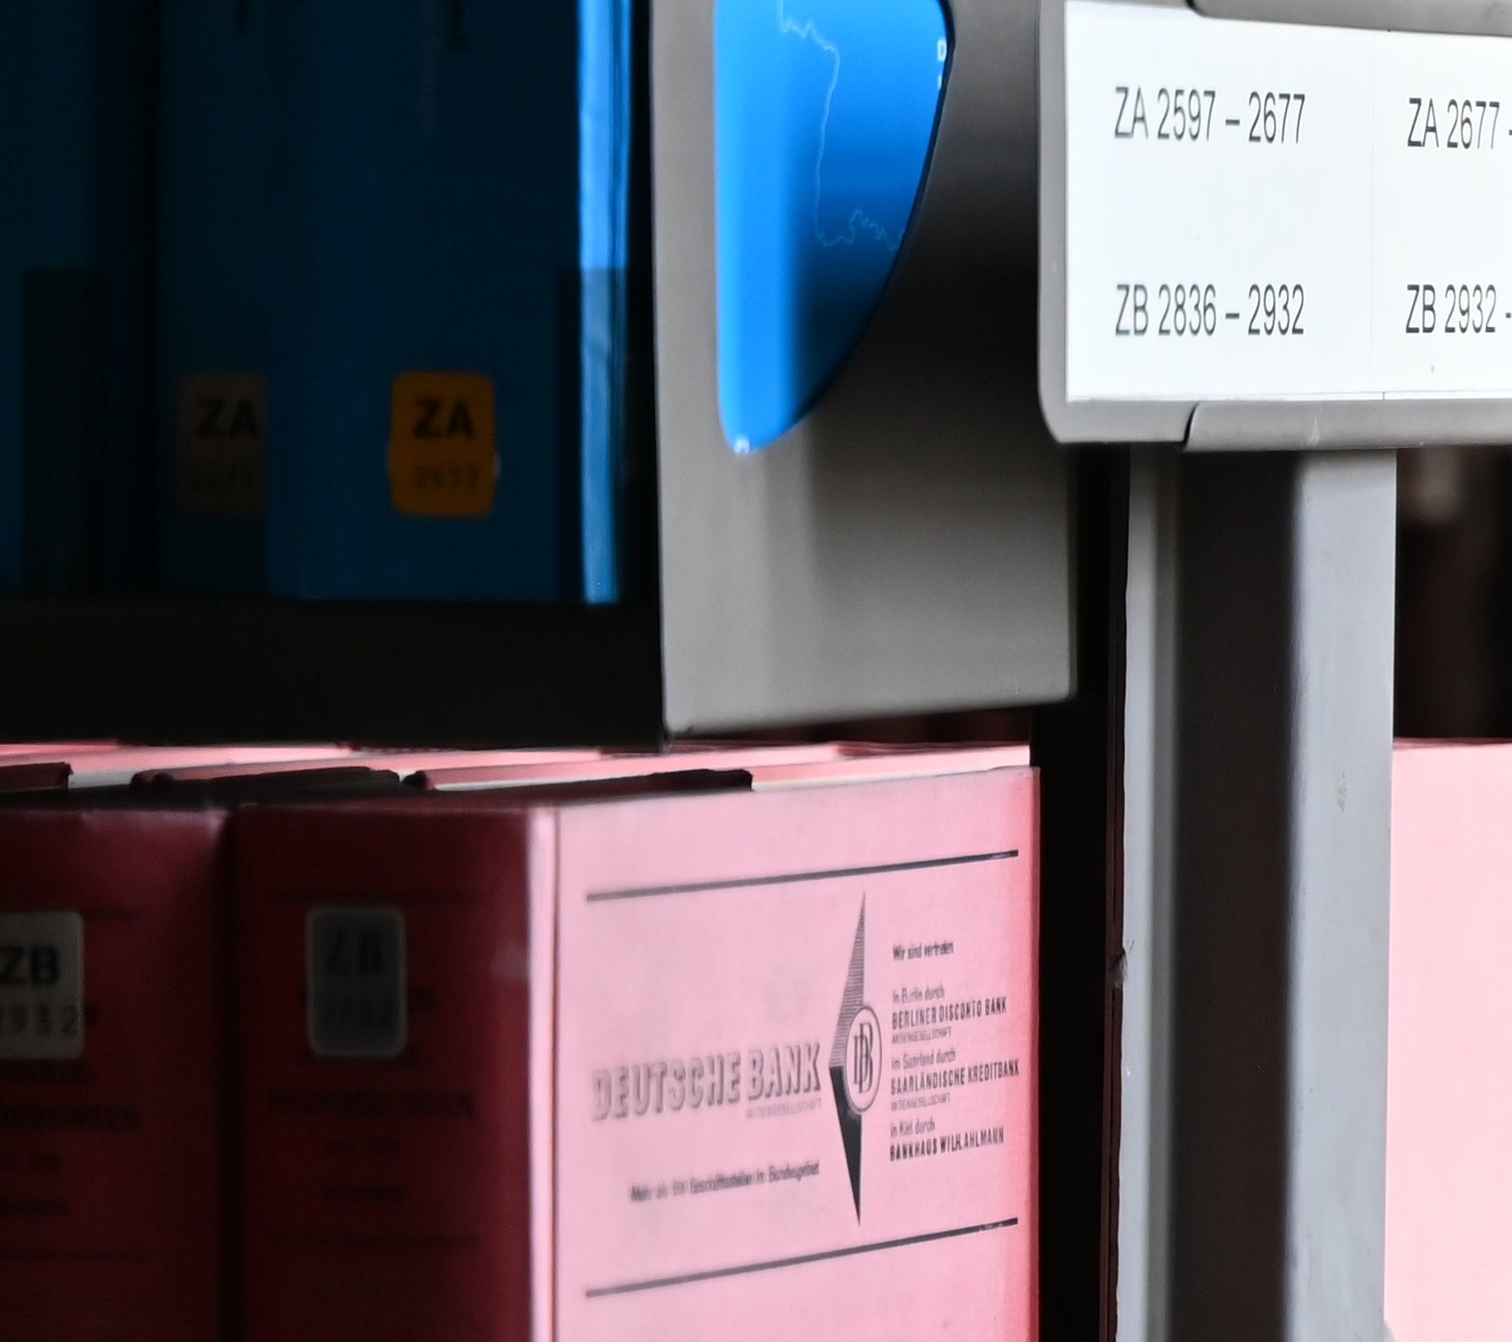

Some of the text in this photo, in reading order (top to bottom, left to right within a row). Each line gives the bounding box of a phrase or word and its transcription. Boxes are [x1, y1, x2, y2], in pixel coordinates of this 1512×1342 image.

[1114, 86, 1149, 139] ZA
[1157, 87, 1216, 142] 2597
[1248, 91, 1306, 144] 2677
[1407, 97, 1439, 147] ZA
[1447, 98, 1500, 149] 2677
[1115, 283, 1149, 336] ZB
[1158, 283, 1217, 337] 2836
[1248, 283, 1305, 336] 2932
[1405, 283, 1437, 334] ZB
[1444, 283, 1497, 334] 2932
[197, 398, 259, 440] ZA
[414, 397, 475, 439] ZA
[0, 944, 59, 985] ZB
[892, 944, 906, 961] Wir
[907, 943, 922, 960] sind
[892, 996, 1008, 1031] BERLINER DISCONTO BANK
[591, 1051, 741, 1121] DEUTSCHE
[748, 1042, 822, 1101] BANK
[891, 1058, 1020, 1095] SAARLÄNDISCHE KREDITBANK
[890, 1137, 938, 1162] BANKHAUS
[964, 1126, 1004, 1149] AHLMANN
